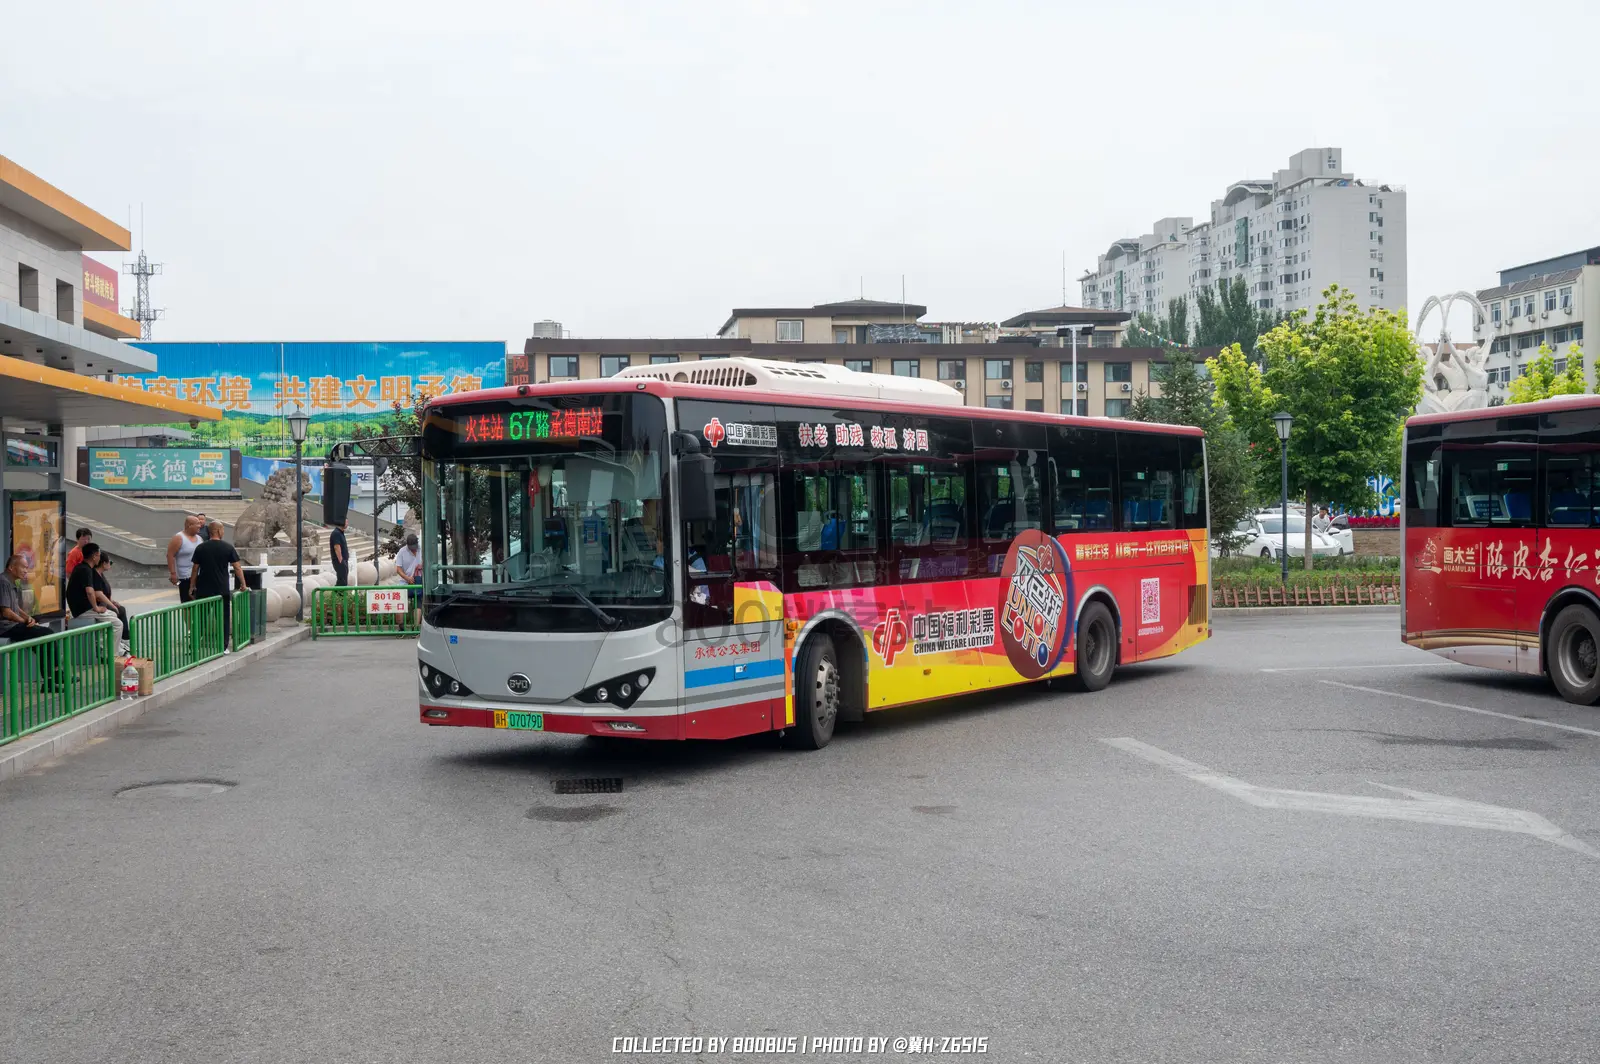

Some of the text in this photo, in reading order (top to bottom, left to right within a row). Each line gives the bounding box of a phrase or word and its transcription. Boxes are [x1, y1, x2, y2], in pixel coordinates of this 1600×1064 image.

[465, 407, 603, 442] 火车站 67路 承德南站
[726, 424, 777, 440] 中国福利彩票
[799, 423, 929, 451] 扶老 助残 救孤 济困
[132, 459, 187, 482] 承德
[1443, 547, 1476, 565] 画木兰
[1443, 565, 1476, 573] HUAMULAN
[374, 592, 401, 600] 801路
[1012, 550, 1064, 631] 双色球
[371, 602, 405, 611] 乘车口
[914, 608, 994, 640] 中国福利彩票
[694, 641, 761, 659] 承德公交集团
[914, 634, 994, 654] CHINA WELFARE LOTTERY
[509, 679, 528, 689] BYD
